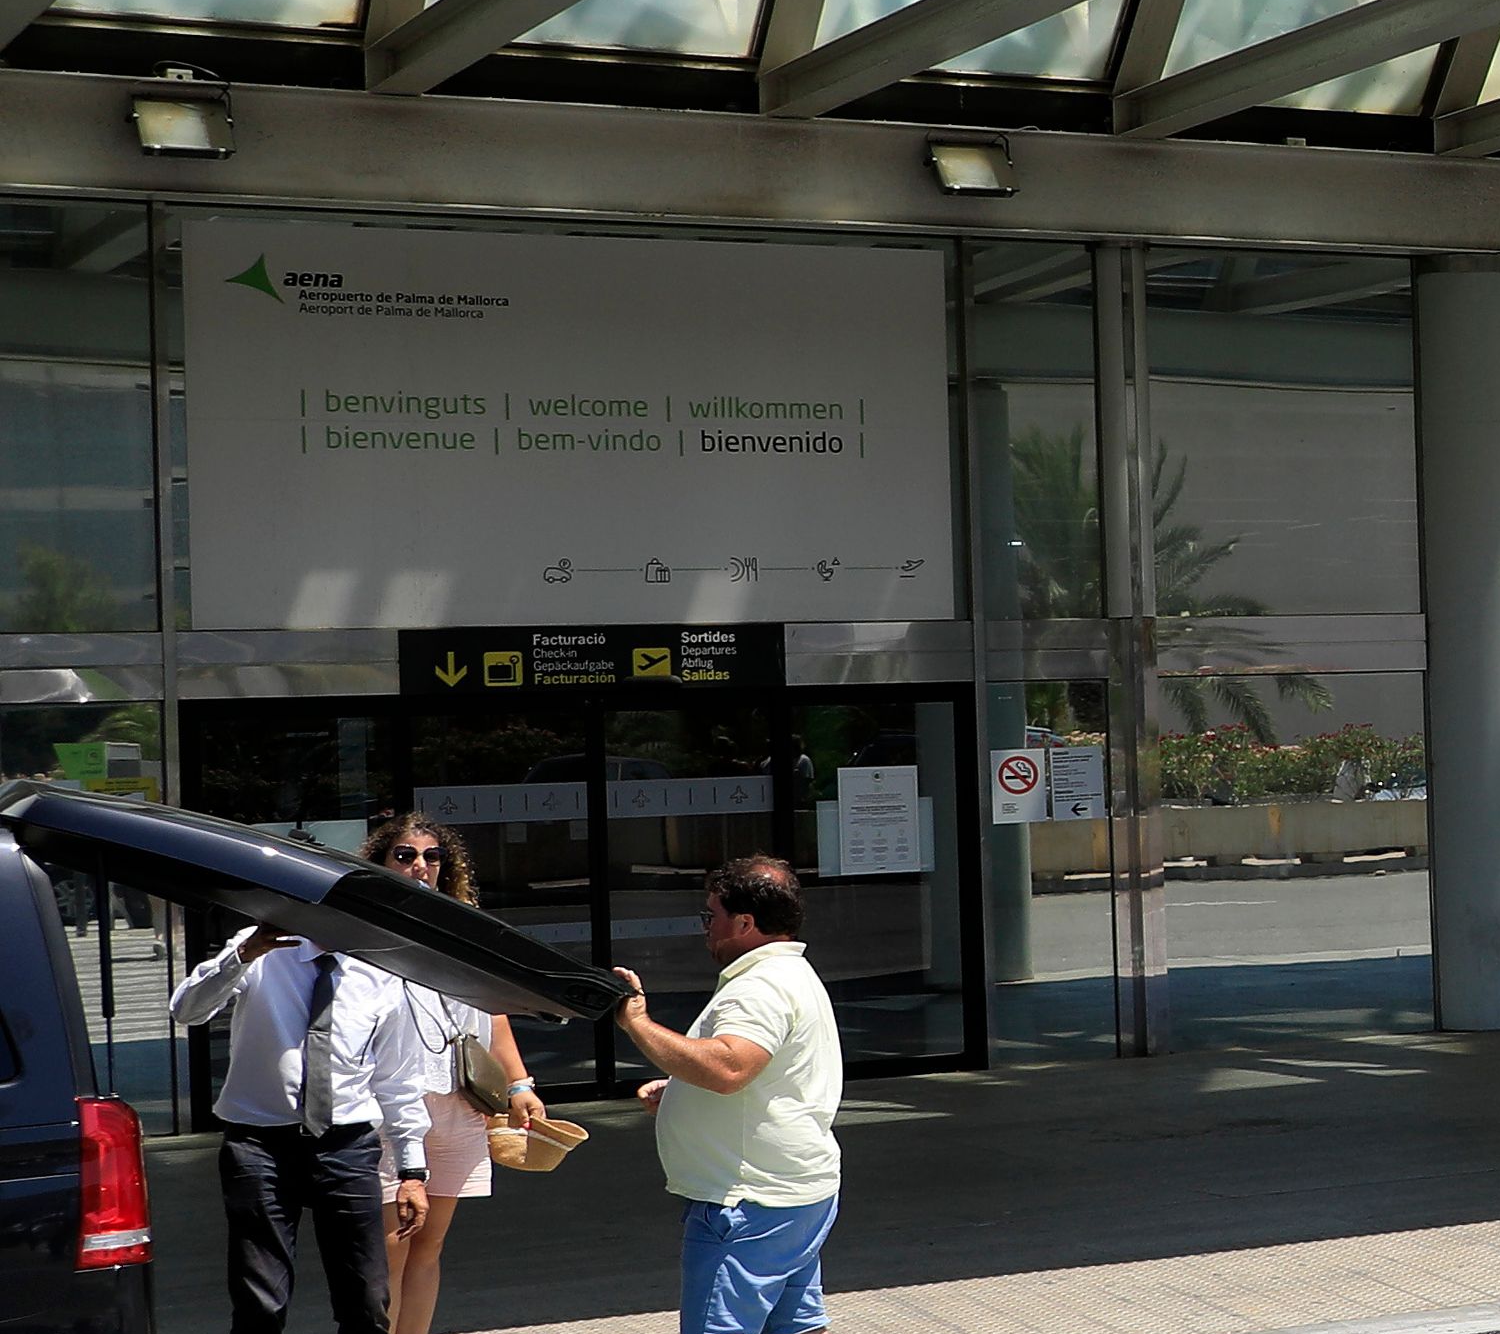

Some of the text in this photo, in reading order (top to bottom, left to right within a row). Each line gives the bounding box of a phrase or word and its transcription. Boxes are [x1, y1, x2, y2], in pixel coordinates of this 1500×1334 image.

[283, 271, 344, 288] aena
[299, 290, 509, 307] Aeropuerto de Palma de Mallorca
[299, 303, 484, 319] Aeroport de Palma de Mallorca
[325, 389, 844, 421] benvinguts welcome willkommen
[325, 426, 844, 455] bienvenue bem-vindo bienvenido
[533, 632, 606, 646] Facturació
[681, 631, 736, 645] Sortides
[533, 648, 578, 659] Check-in
[681, 644, 737, 657] Departures
[533, 660, 615, 673] Gepäckaufgabe
[681, 657, 714, 670] Abflug
[534, 672, 616, 685] Facturación
[682, 669, 731, 681] Salidas
